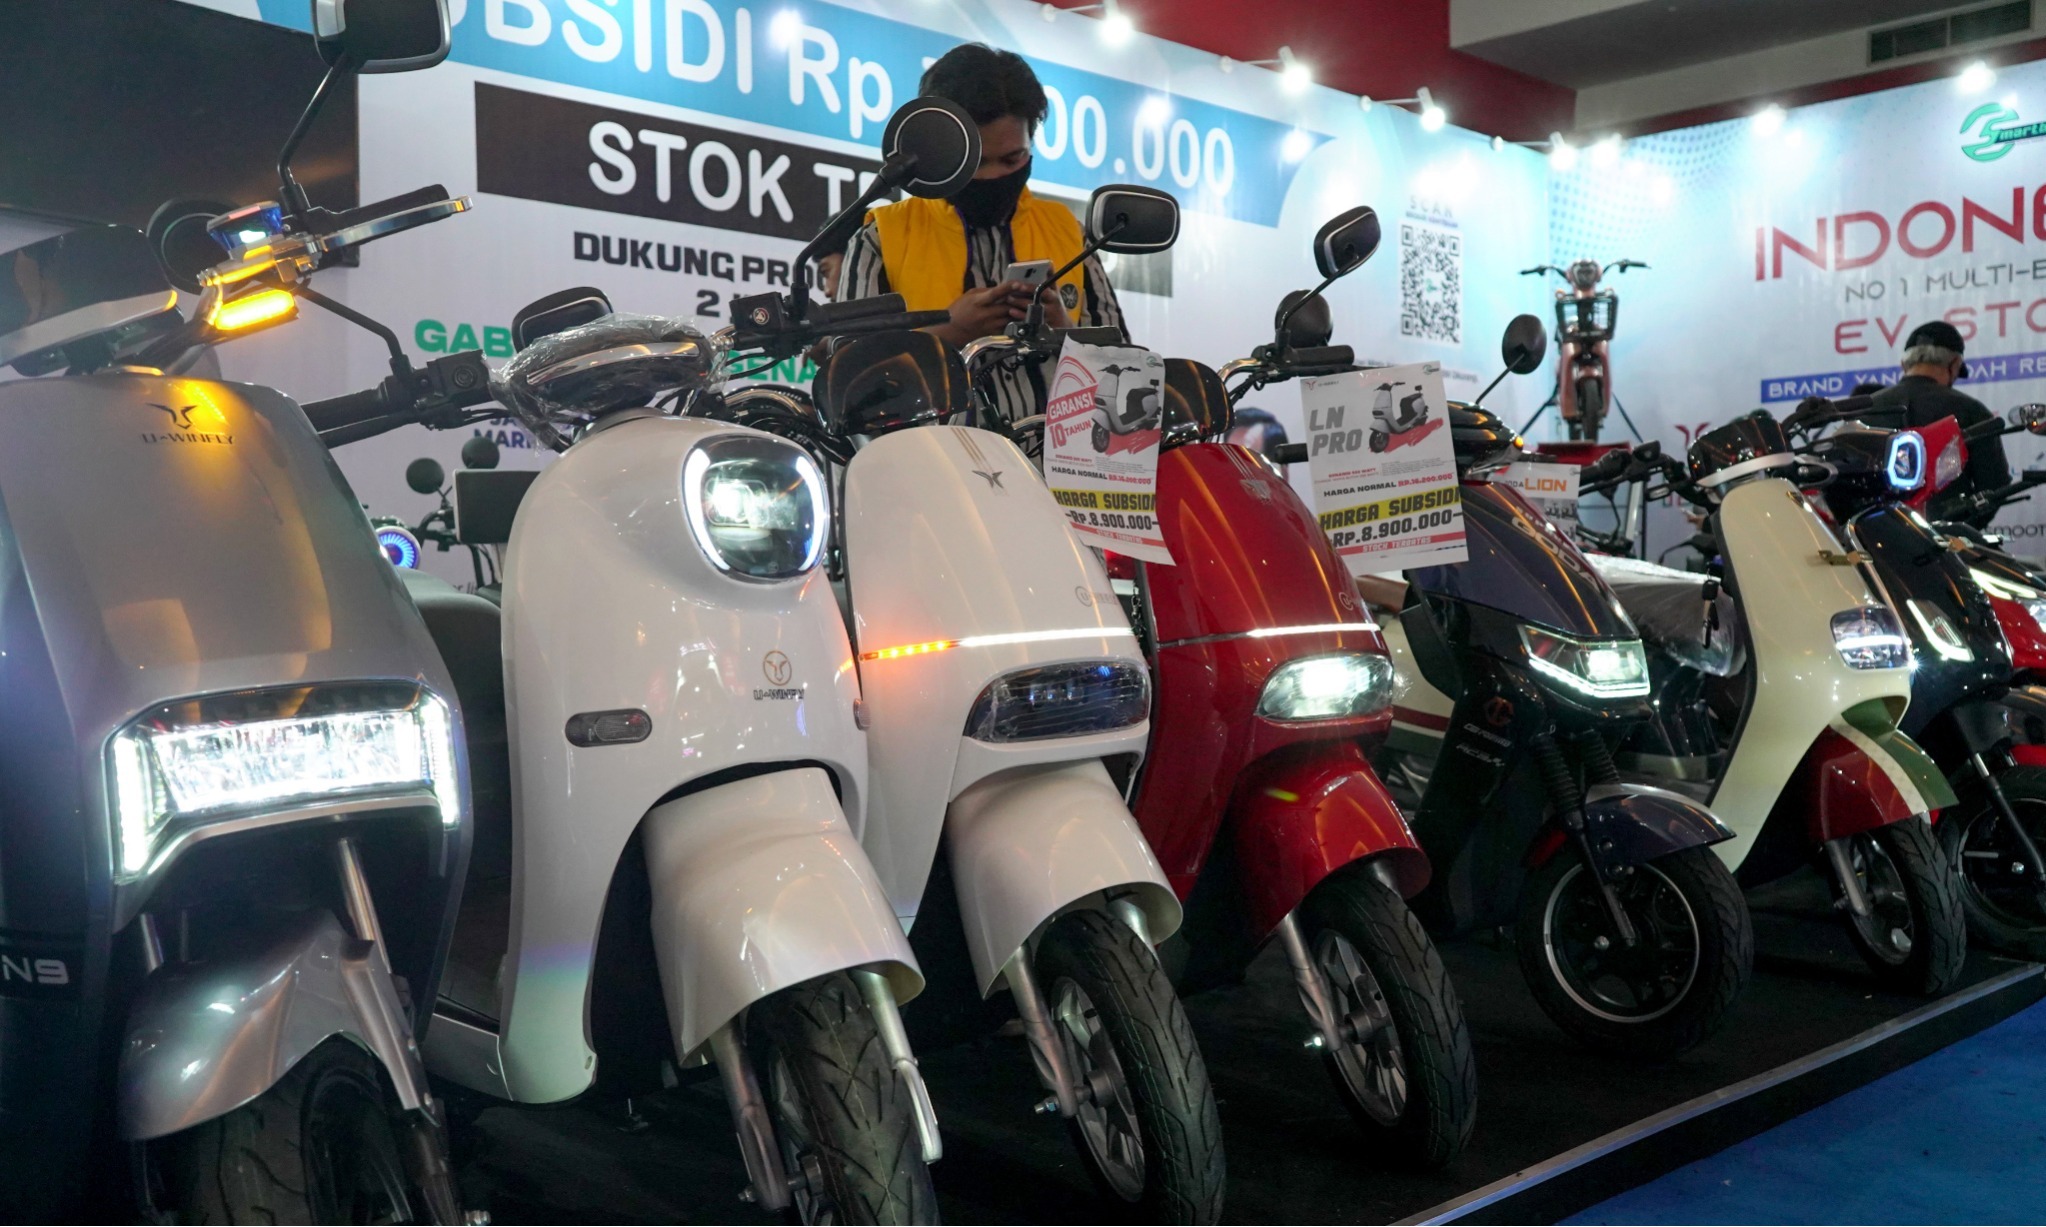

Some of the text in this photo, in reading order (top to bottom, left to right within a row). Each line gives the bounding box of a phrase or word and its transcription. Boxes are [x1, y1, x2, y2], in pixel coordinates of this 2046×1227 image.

[790, 22, 893, 140] Rp
[588, 121, 794, 223] STOK
[573, 231, 735, 283] DUKUNG
[696, 289, 720, 317] 2
[1845, 280, 1885, 303] NO
[1835, 314, 1908, 355] EV
[1769, 376, 1843, 399] BRAND
[1049, 392, 1094, 420] GARANSI
[1309, 405, 1345, 432] LN
[1049, 419, 1092, 449] 10 TAHUN
[1312, 428, 1363, 457] PRO
[1052, 465, 1077, 476] HARGA
[1078, 468, 1108, 481] NORMAL
[1524, 478, 1567, 492] LION
[1053, 490, 1156, 511] HARGA SUBSIDI
[1323, 487, 1355, 497] HARGA
[1357, 481, 1397, 492] NORMAL
[1319, 486, 1462, 530] HARGA SUBSIDI
[2, 954, 69, 984] N9
